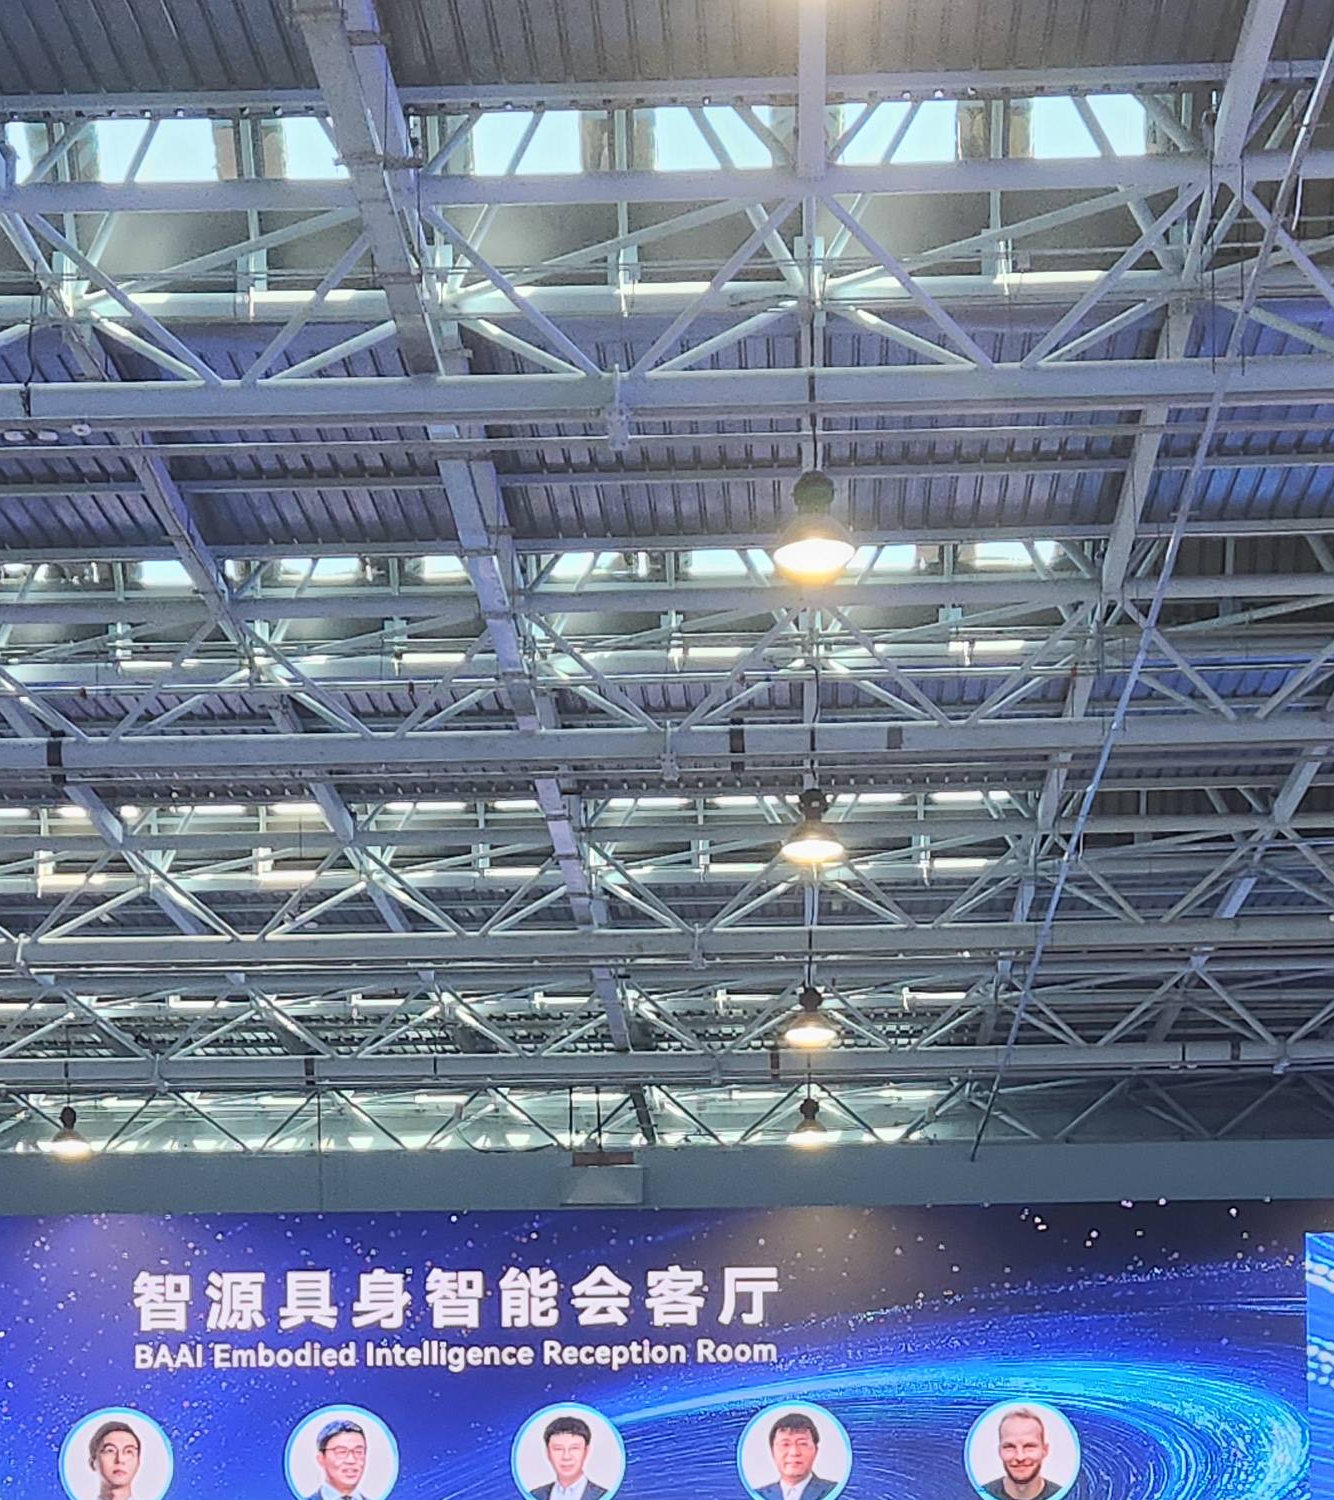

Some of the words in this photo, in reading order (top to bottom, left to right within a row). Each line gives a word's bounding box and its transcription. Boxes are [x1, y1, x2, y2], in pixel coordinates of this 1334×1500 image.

[132, 1265, 779, 1331] 智源具身智能会客厅
[134, 1342, 203, 1369] BAAI
[213, 1340, 356, 1369] Embodied
[367, 1338, 534, 1372] Intelligence
[543, 1338, 687, 1371] Reception
[697, 1337, 778, 1363] Room
